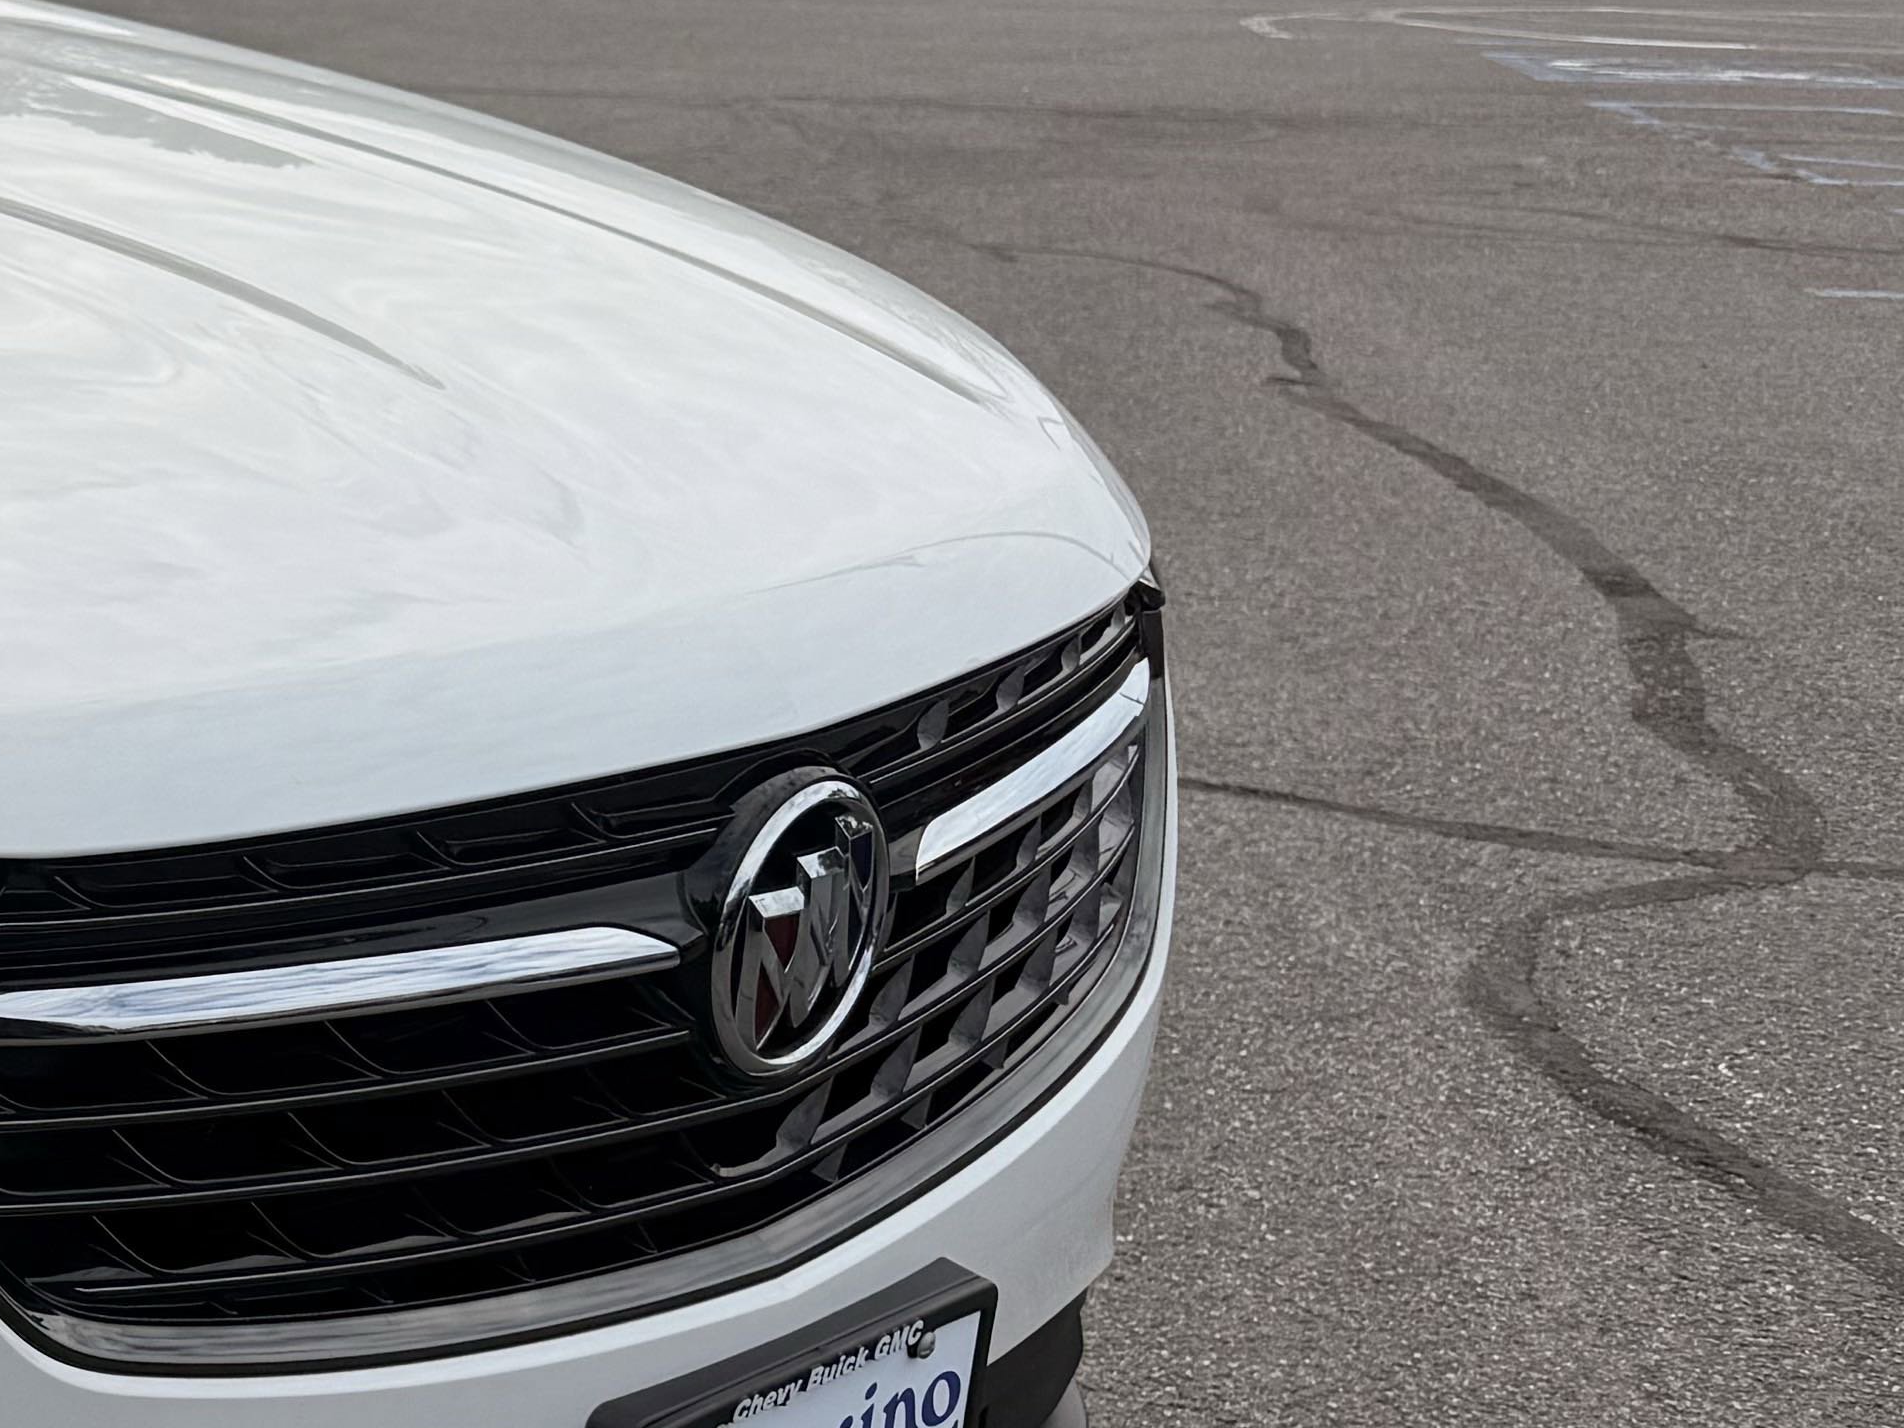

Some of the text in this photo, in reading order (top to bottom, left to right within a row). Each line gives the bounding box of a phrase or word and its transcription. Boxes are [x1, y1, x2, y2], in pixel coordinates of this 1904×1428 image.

[732, 1319, 924, 1422] Chevy Buick GMC
